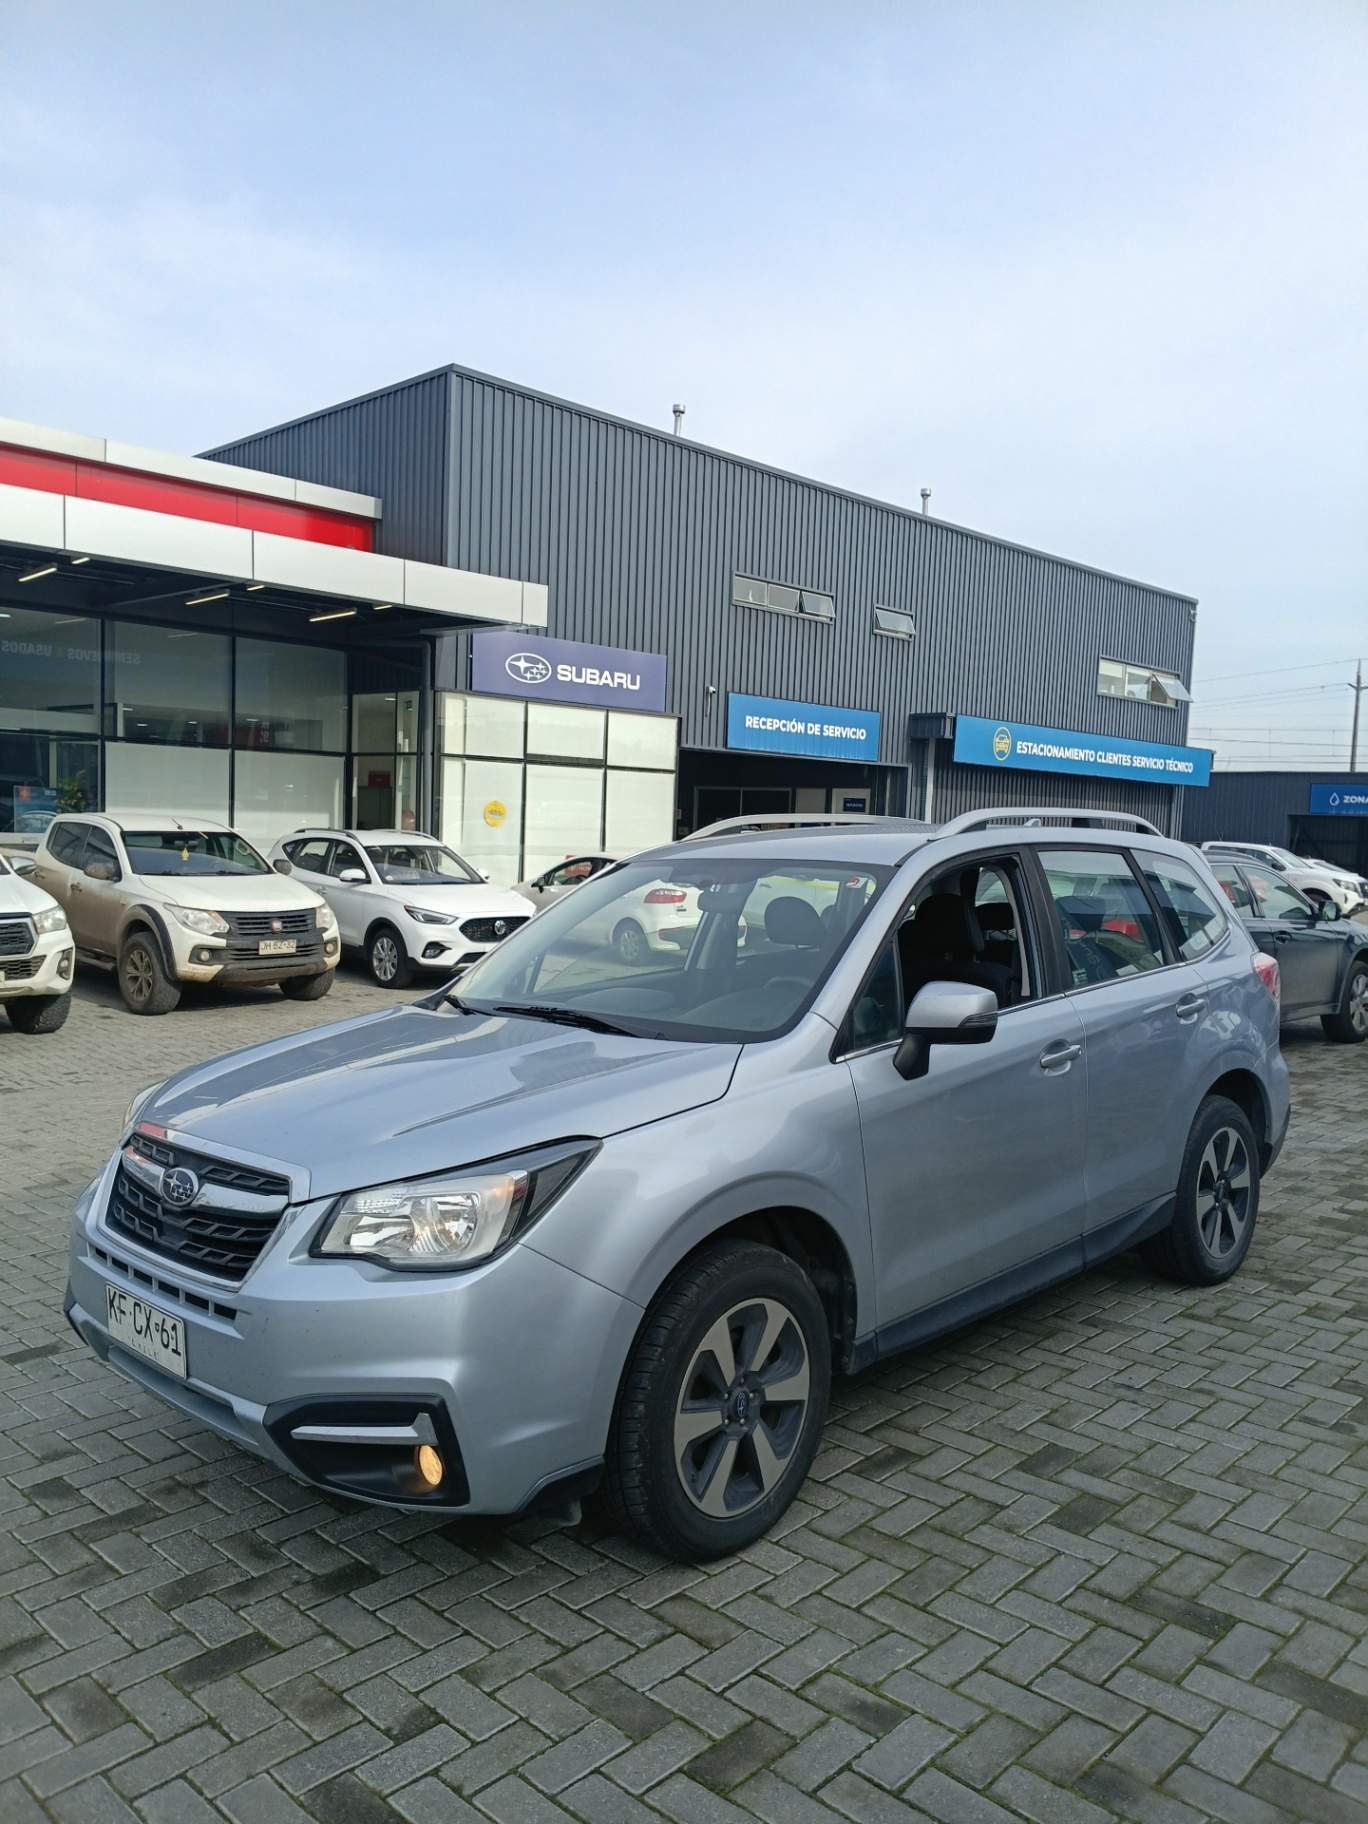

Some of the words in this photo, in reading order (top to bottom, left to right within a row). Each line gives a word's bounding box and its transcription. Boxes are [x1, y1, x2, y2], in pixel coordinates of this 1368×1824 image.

[557, 664, 641, 690] SUBARU
[745, 715, 805, 734] RECEPCIÓN
[807, 723, 821, 736] DE
[823, 725, 867, 740] SERVICIO
[1016, 740, 1095, 762] ESTACIONAMIENTO
[1096, 751, 1131, 767] CLIENTES
[1132, 755, 1164, 770] SERVICIO
[1165, 757, 1193, 773] TÉCNICO
